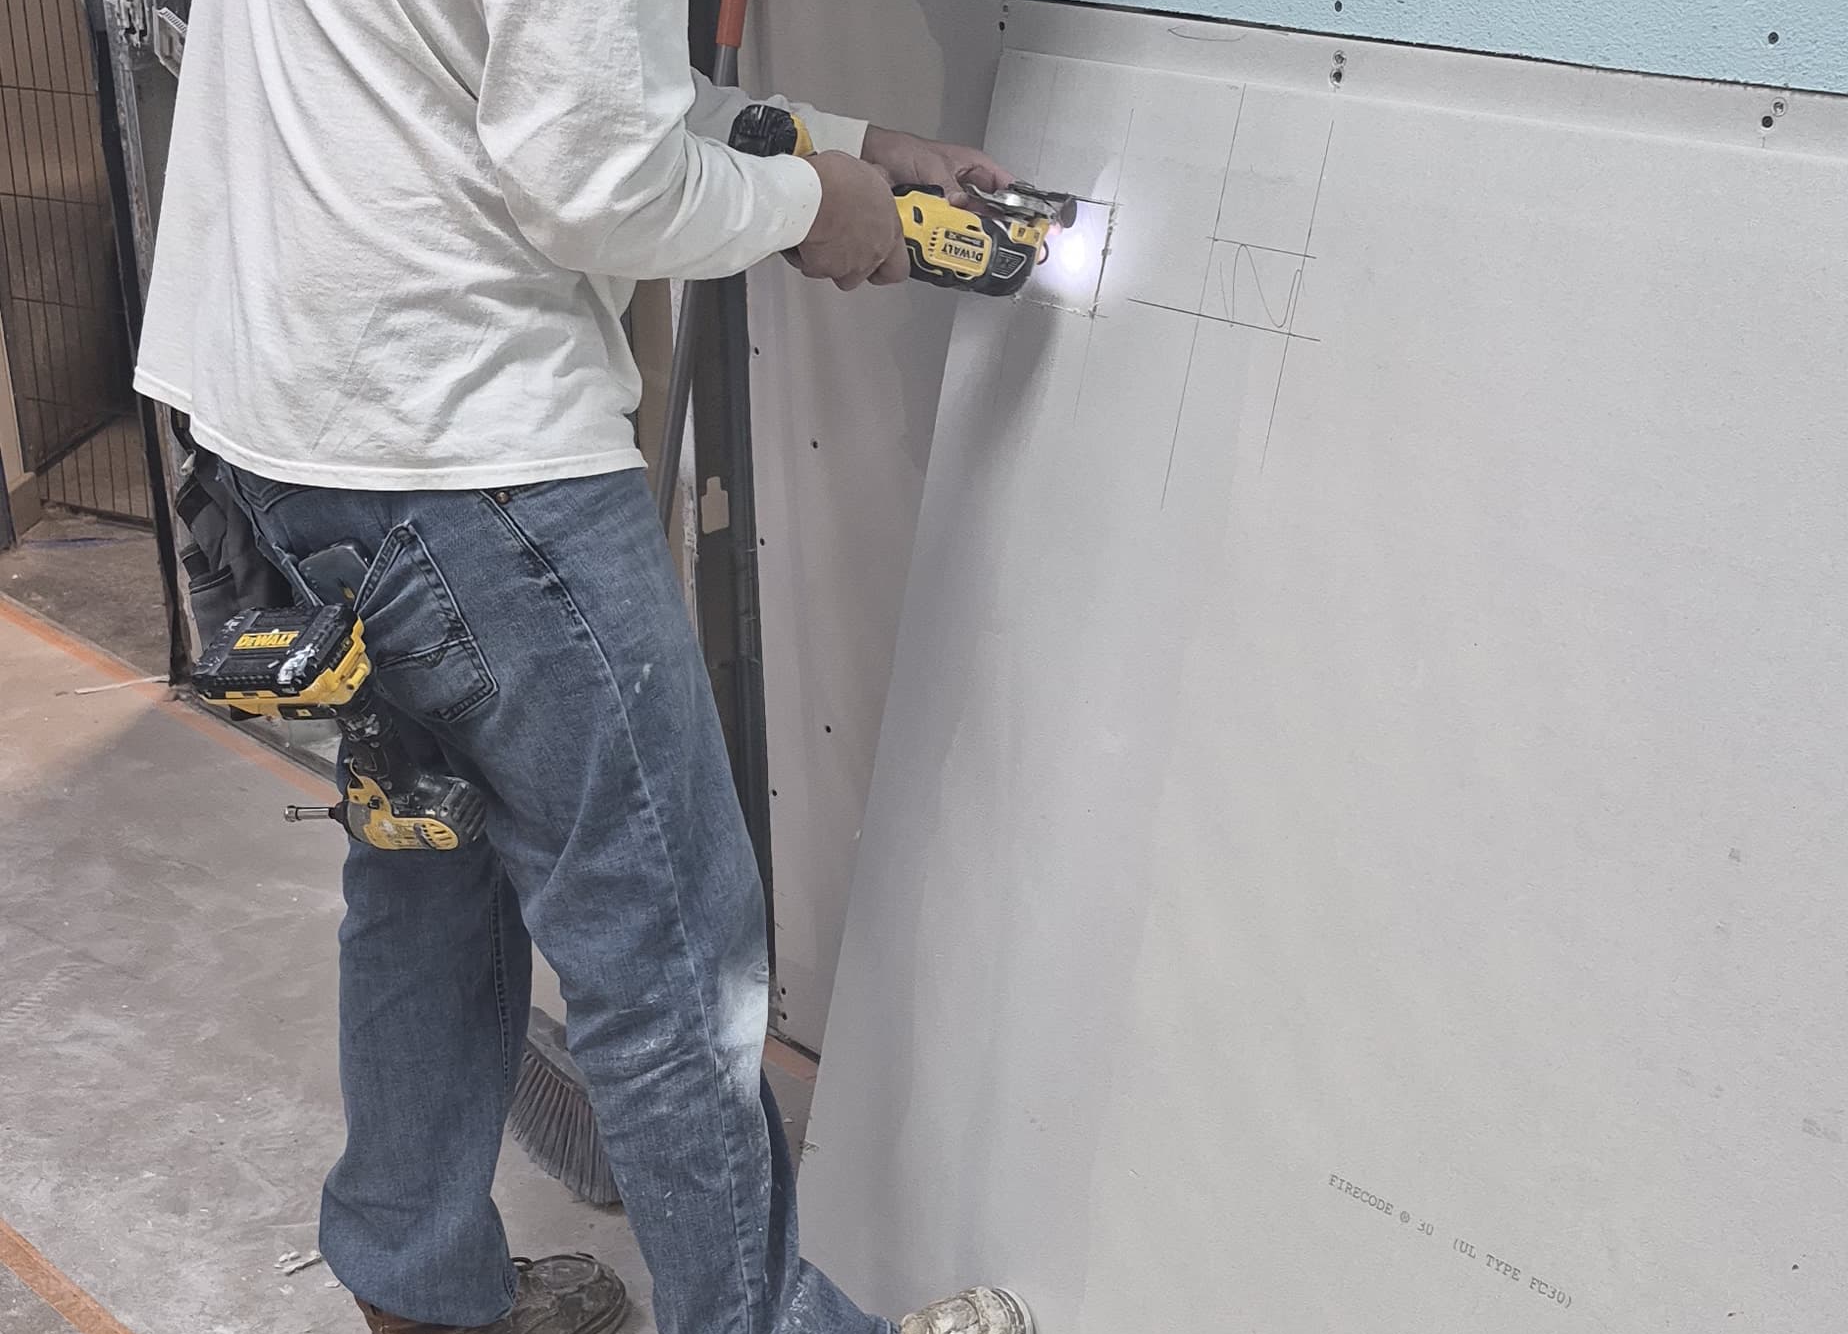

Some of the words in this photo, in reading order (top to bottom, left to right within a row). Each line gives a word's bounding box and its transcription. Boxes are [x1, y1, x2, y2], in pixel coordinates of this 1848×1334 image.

[1328, 1173, 1394, 1216] FIRECODE
[1417, 1219, 1434, 1236] 30
[1452, 1237, 1477, 1259] (UL
[1485, 1253, 1521, 1281] TYPE
[1529, 1276, 1573, 1309] FC30)
